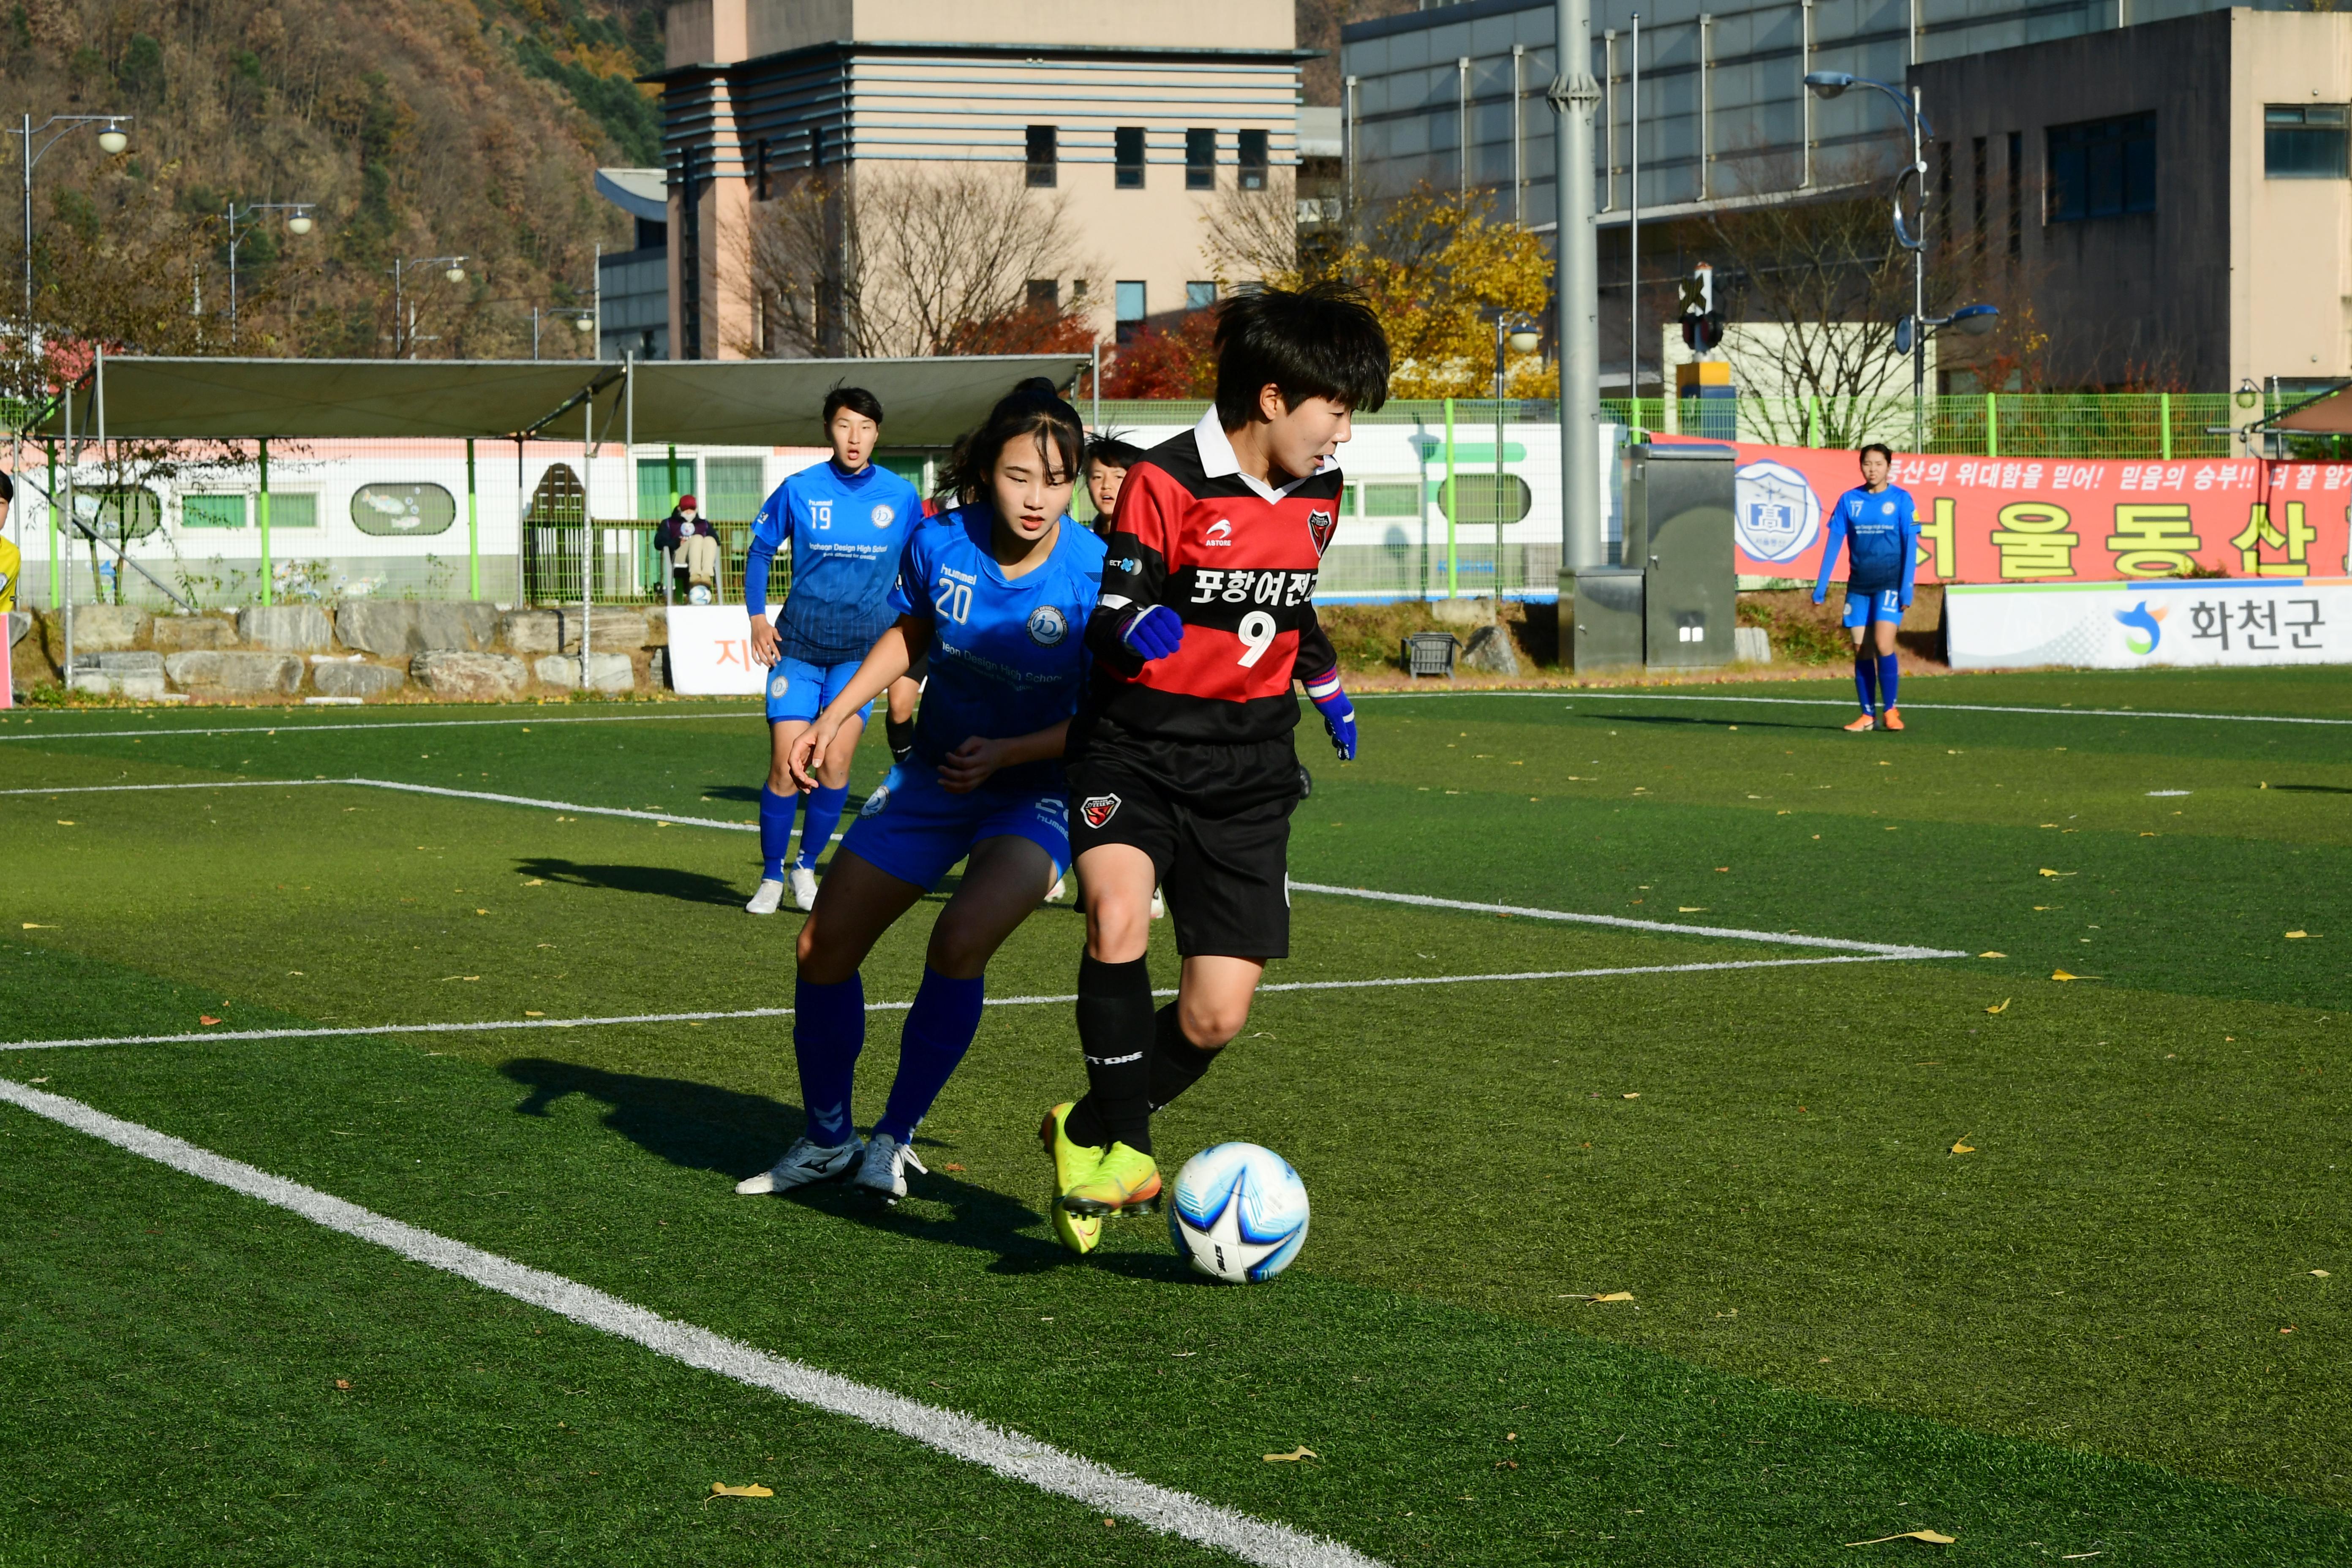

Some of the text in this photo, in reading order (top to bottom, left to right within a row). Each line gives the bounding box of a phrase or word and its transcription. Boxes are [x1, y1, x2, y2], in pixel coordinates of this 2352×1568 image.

[1956, 461, 2043, 489] 위대함을
[2052, 465, 2105, 490] 믿어!
[2120, 465, 2186, 490] 믿음의
[2194, 465, 2255, 489] 승부!!
[2270, 464, 2289, 490] 더
[2296, 464, 2317, 490] 잘
[811, 507, 831, 529] 19
[1851, 504, 1862, 517] 17
[809, 542, 832, 551] Incheon
[834, 544, 855, 553] Design
[857, 545, 871, 553] High
[940, 563, 977, 585] hummel
[936, 578, 972, 625] 20
[1884, 590, 1898, 607] 17
[1238, 611, 1276, 668] 9
[2189, 599, 2326, 651] 화천군
[964, 650, 997, 670] Design
[1001, 664, 1021, 681] High
[1026, 672, 1062, 683] Schoo
[1037, 813, 1069, 842] humme
